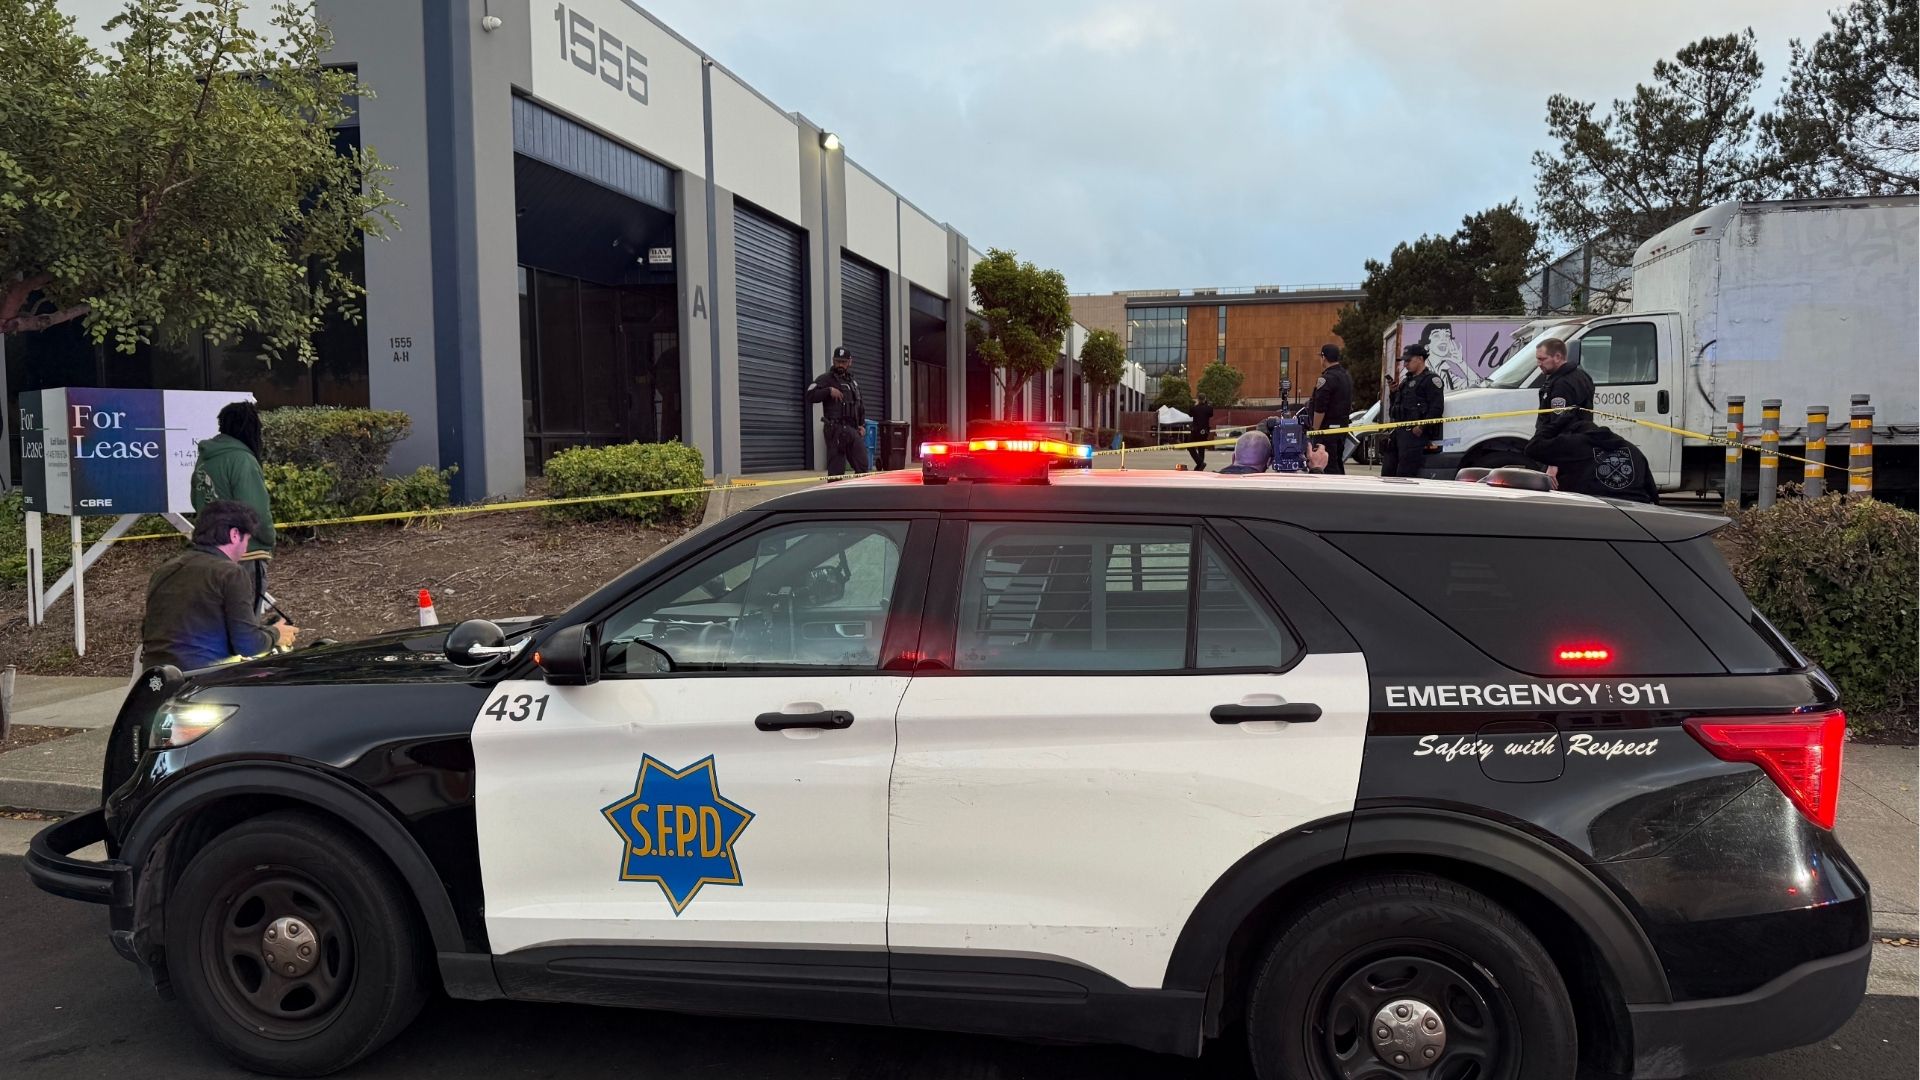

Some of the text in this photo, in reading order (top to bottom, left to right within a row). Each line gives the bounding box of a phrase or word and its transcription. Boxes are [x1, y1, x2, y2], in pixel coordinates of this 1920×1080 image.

[554, 2, 648, 106] 1555
[692, 284, 707, 320] A
[390, 337, 412, 349] 1555
[903, 344, 910, 366] B
[20, 408, 34, 431] For
[71, 404, 127, 429] For
[21, 436, 43, 459] Lease
[73, 434, 160, 459] Lease
[80, 498, 113, 507] CBRE
[1385, 683, 1601, 707] EMERGENCY
[1617, 683, 1670, 705] 911
[485, 694, 551, 722] 431
[1413, 733, 1659, 762] Safety with Respect
[630, 803, 728, 859] S.F.P.D.
